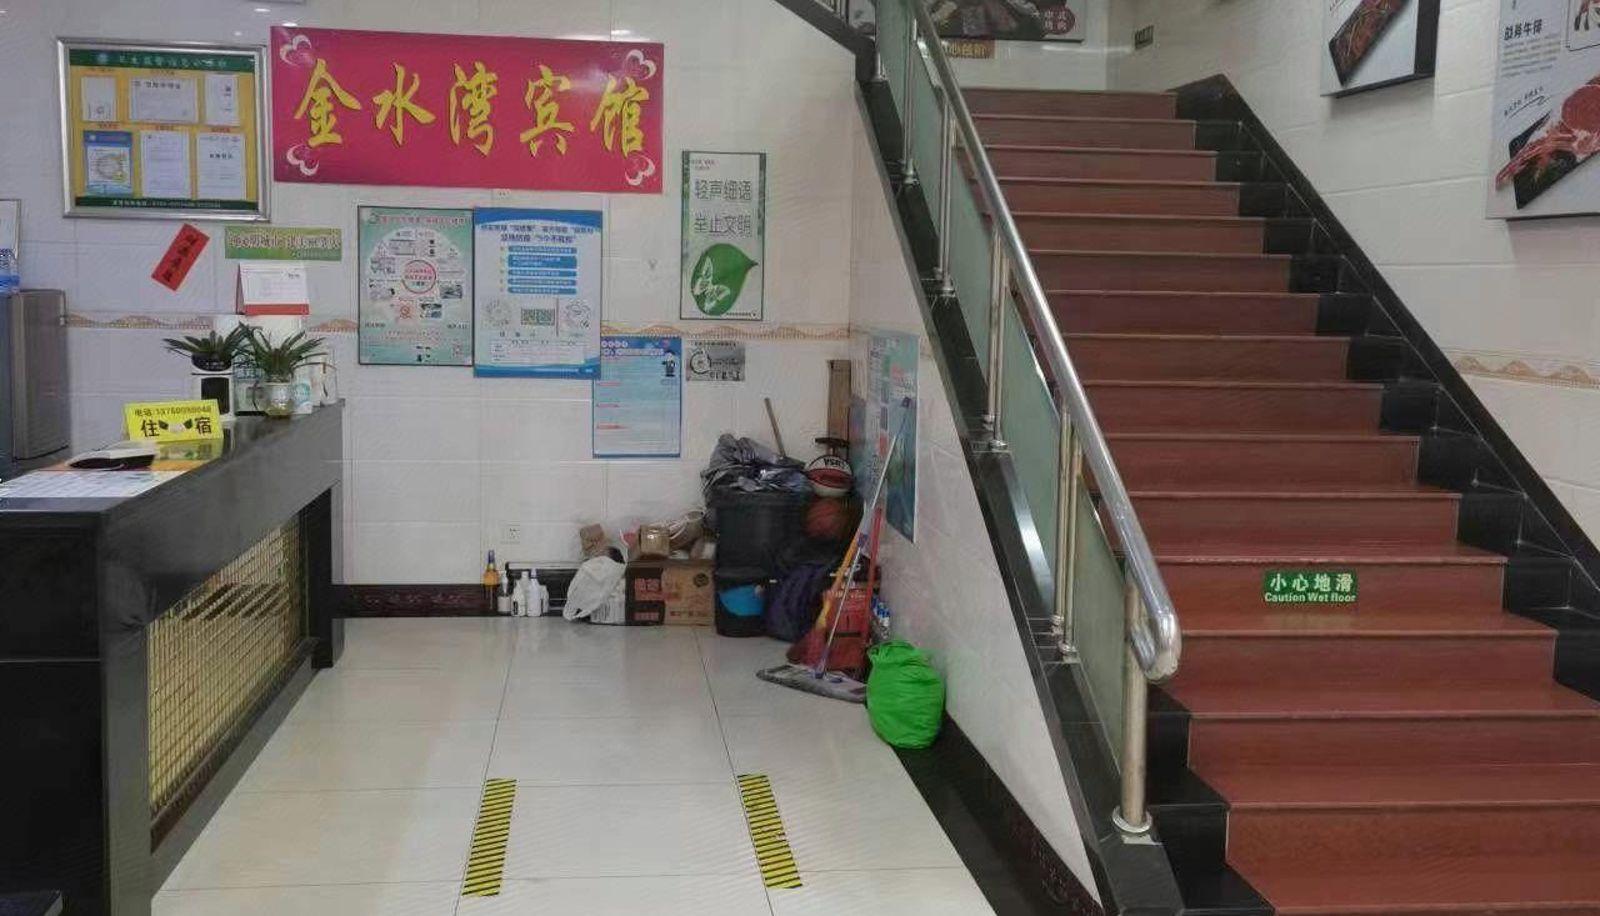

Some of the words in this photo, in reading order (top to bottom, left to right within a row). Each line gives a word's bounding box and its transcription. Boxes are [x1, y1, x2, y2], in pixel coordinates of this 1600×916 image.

[945, 41, 987, 57] 心台阶
[294, 57, 651, 158] 金水湾宾馆
[694, 178, 753, 201] 轻声细语
[694, 212, 753, 237] 举止文明
[141, 419, 160, 437] 住
[194, 417, 212, 435] 宿
[1269, 572, 1354, 592] 小心地滑
[1264, 592, 1306, 602] Caution
[1307, 592, 1329, 602] Wet
